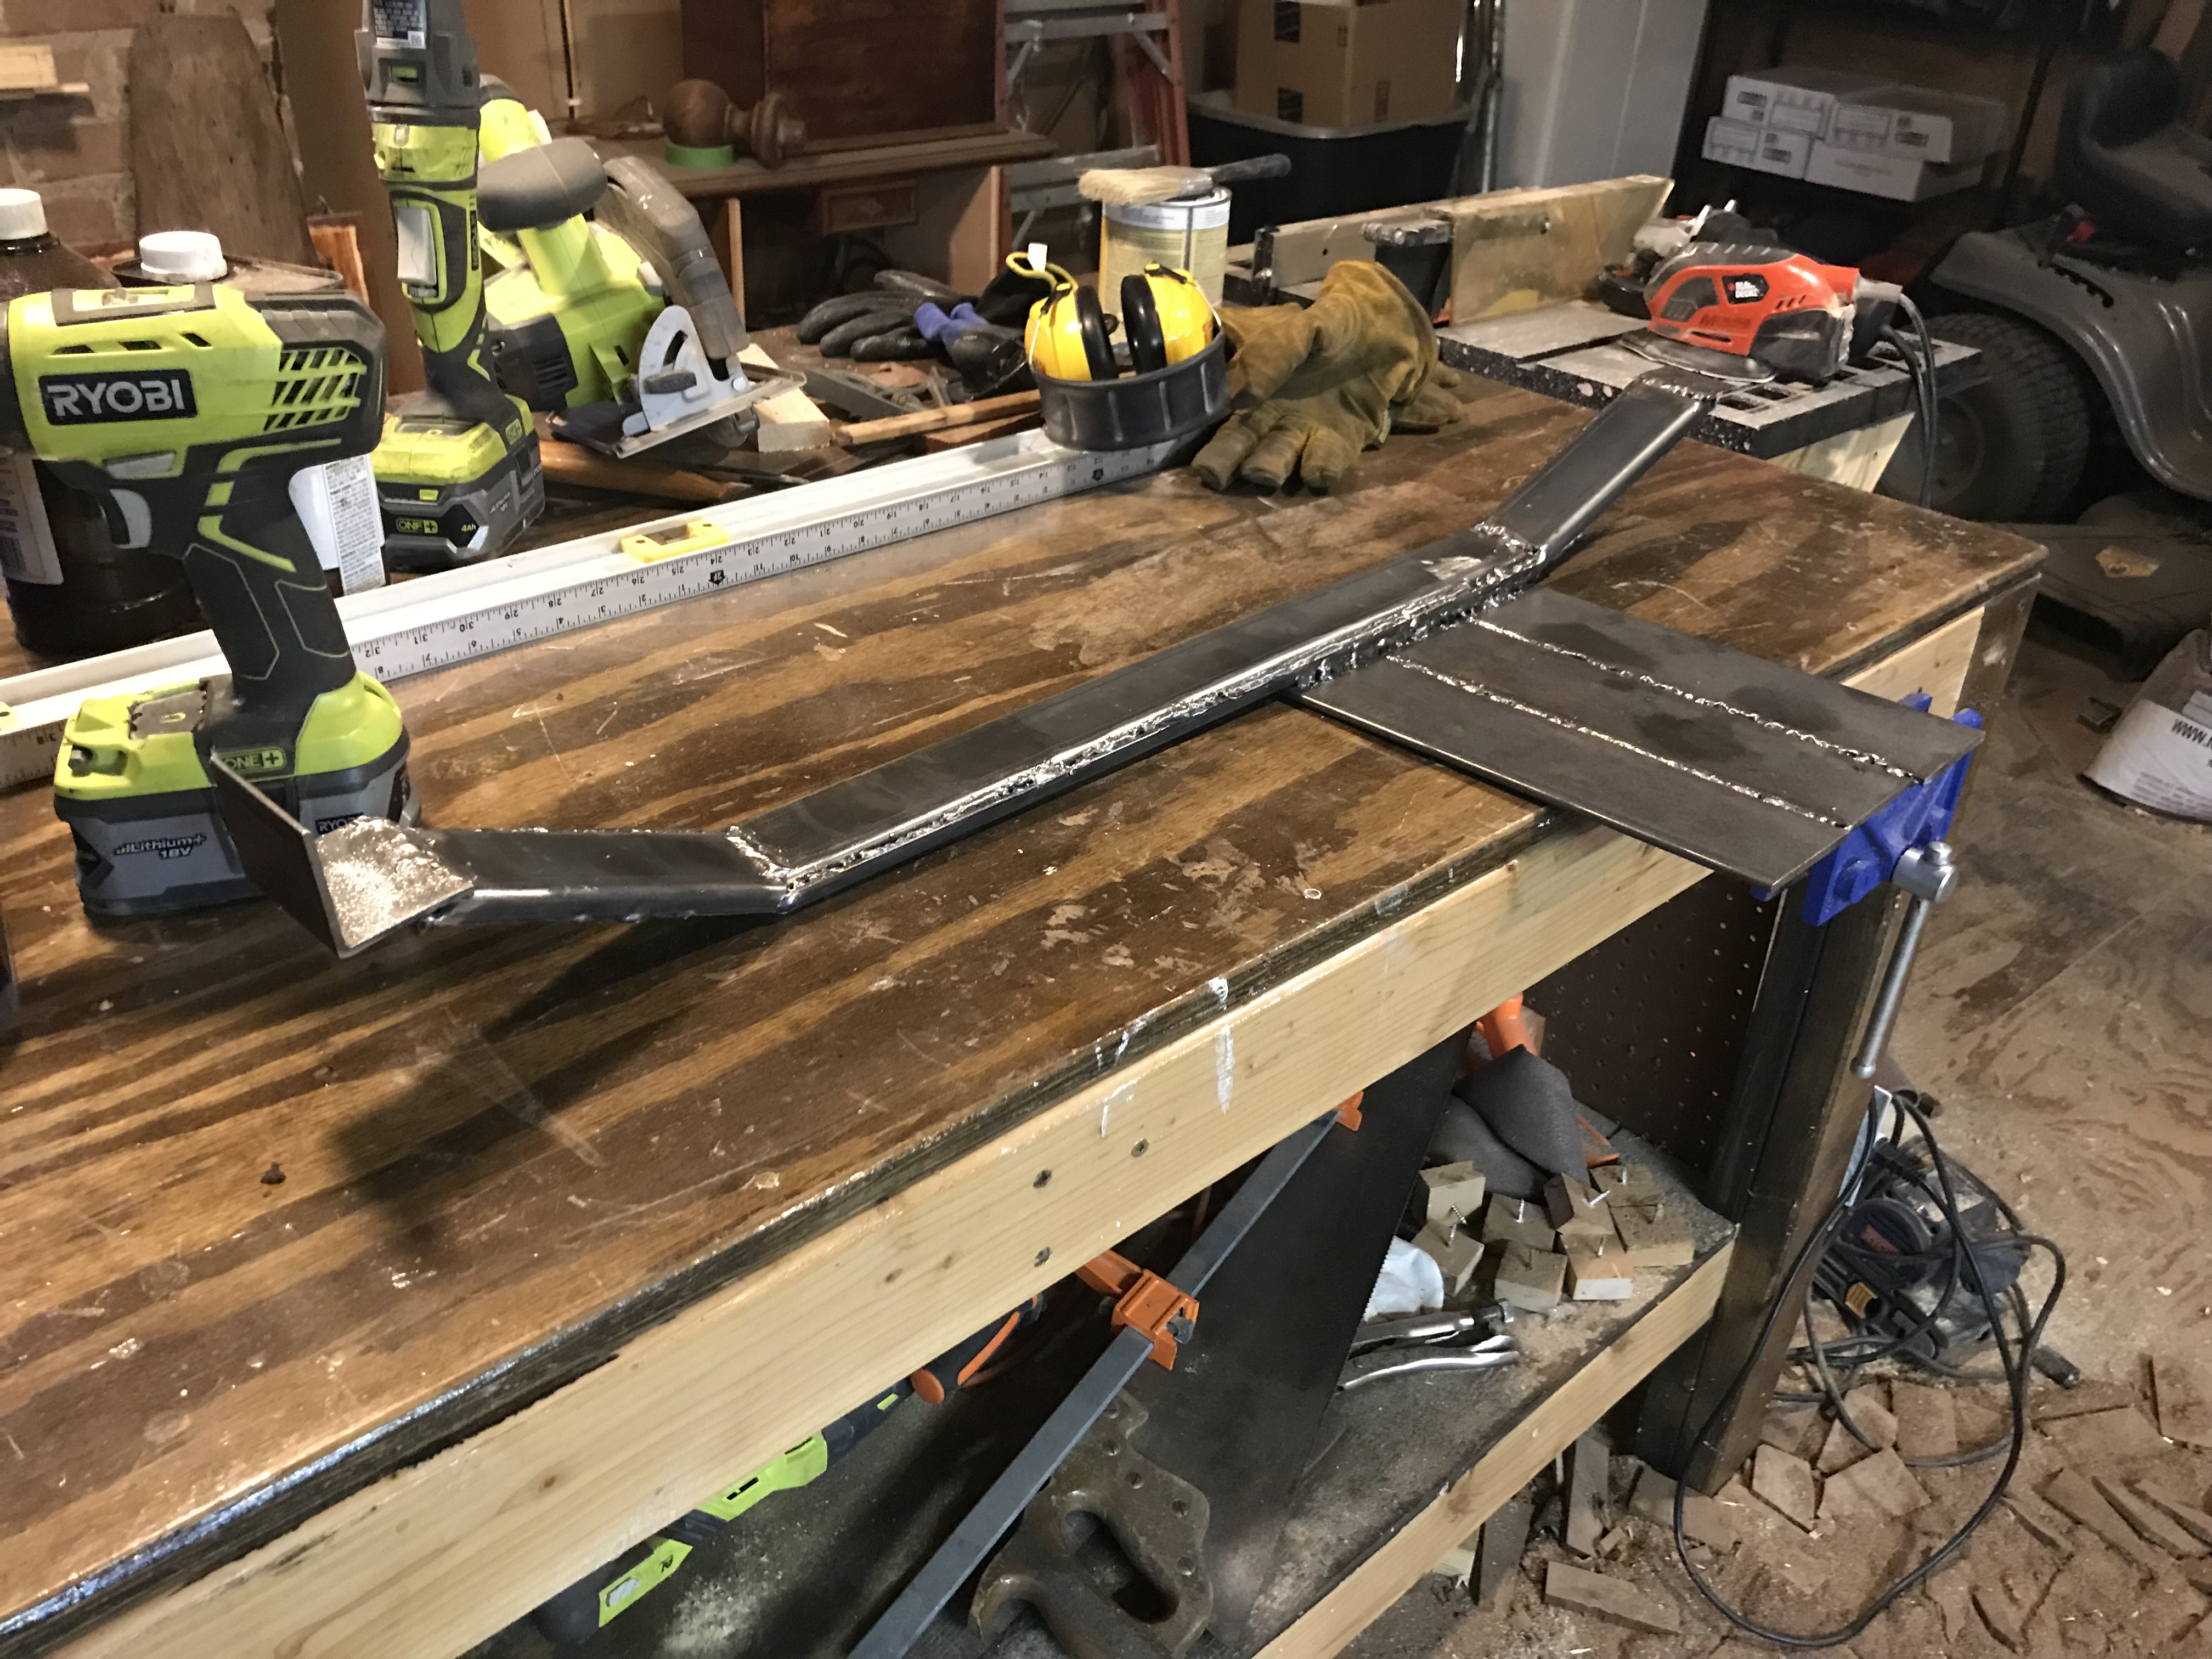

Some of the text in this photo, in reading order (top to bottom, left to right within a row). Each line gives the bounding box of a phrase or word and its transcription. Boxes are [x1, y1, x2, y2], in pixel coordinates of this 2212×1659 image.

[47, 379, 185, 416] RYOBI
[950, 494, 960, 503] 17
[918, 502, 929, 511] 18
[886, 510, 897, 520] 19
[461, 524, 476, 532] 4Ah
[853, 519, 865, 528] 20
[820, 528, 831, 537] 21
[784, 537, 796, 546] 22
[860, 535, 865, 543] 8
[747, 546, 760, 556] 23
[826, 544, 832, 552] 9
[710, 555, 723, 566] 24
[791, 554, 799, 562] 10
[671, 566, 685, 575] 25
[755, 563, 763, 571] 11
[631, 576, 645, 586] 26
[591, 586, 605, 597] 27
[548, 597, 562, 608] 28
[641, 594, 647, 602] 2
[600, 605, 607, 613] 3
[504, 610, 519, 620] 29
[558, 617, 564, 625] 4
[459, 621, 474, 633] 30
[516, 628, 522, 636] 5
[414, 634, 428, 645] 31
[471, 640, 477, 648] 6
[365, 646, 381, 658] 32
[425, 653, 431, 662] 7
[378, 665, 384, 674] 8
[317, 817, 355, 832] RYO
[160, 847, 191, 859] 18V
